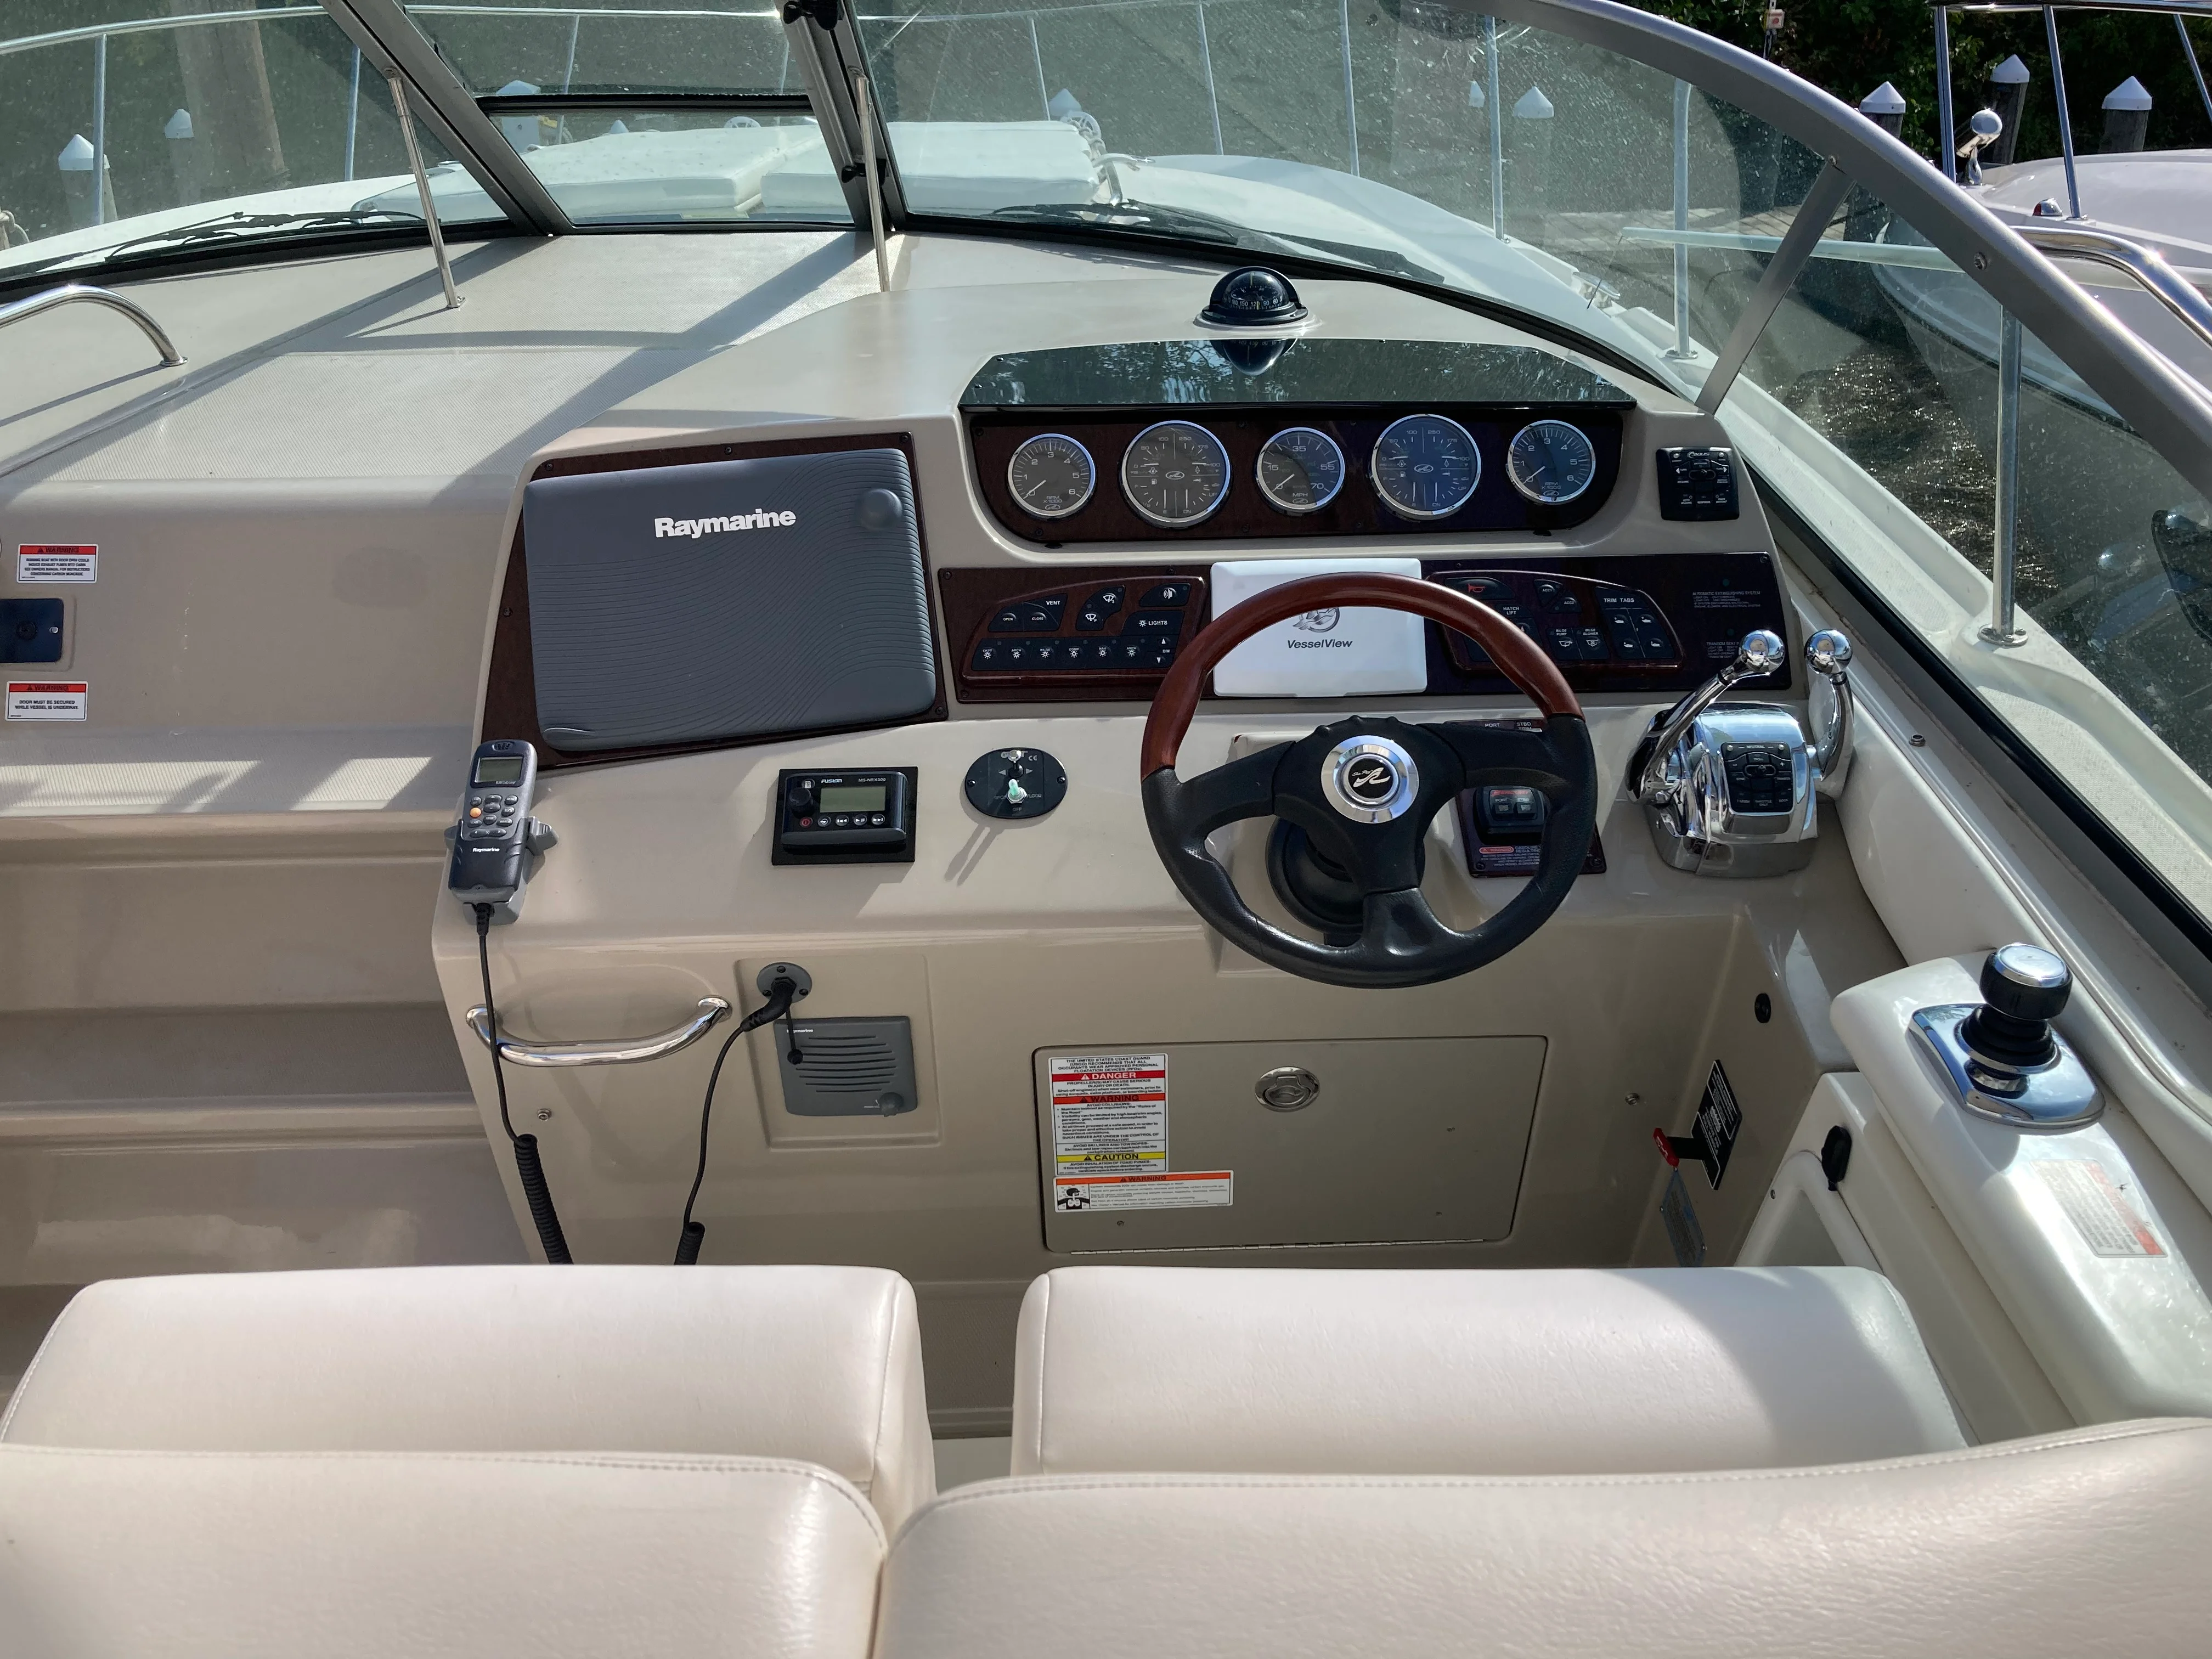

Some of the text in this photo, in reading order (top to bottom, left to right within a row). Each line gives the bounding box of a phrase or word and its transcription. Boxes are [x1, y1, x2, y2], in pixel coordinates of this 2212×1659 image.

[654, 508, 796, 539] Raymarine
[1287, 639, 1353, 648] VesselView
[1091, 1094, 1139, 1103] WARNING
